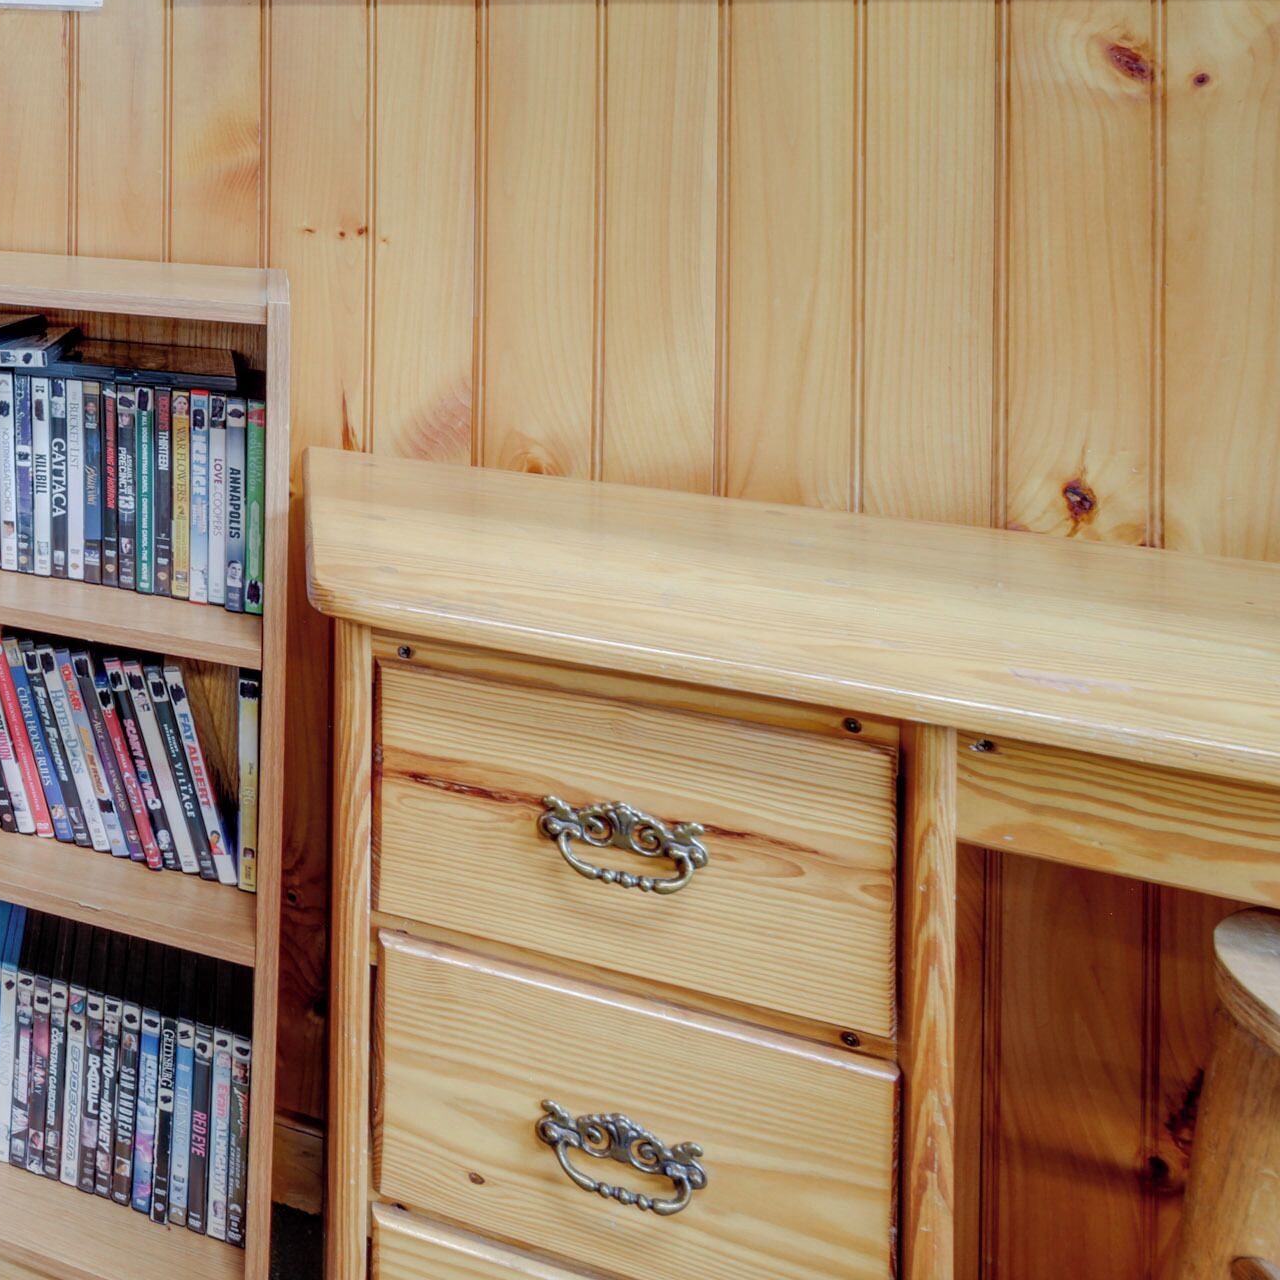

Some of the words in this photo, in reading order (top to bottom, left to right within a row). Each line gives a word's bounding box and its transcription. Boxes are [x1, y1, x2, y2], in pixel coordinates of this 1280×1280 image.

[158, 431, 168, 470] THIRTEEN
[176, 427, 186, 451] WAR
[51, 438, 66, 518] GATTACA
[176, 453, 186, 502] FLOWERS
[214, 458, 223, 484] LOVE
[228, 467, 241, 539] ANNAPOLIS
[16, 687, 33, 718] CIDER
[25, 720, 44, 756] HOUSE
[36, 756, 53, 786] RULES
[179, 712, 195, 742] FAT
[187, 744, 211, 809] ALBERT
[103, 1046, 114, 1077] TWO
[121, 1065, 135, 1088] SAN
[98, 1102, 112, 1152] MONEY
[117, 1091, 135, 1145] ANDREAS
[193, 1111, 207, 1133] RED
[191, 1134, 206, 1157] EYE
